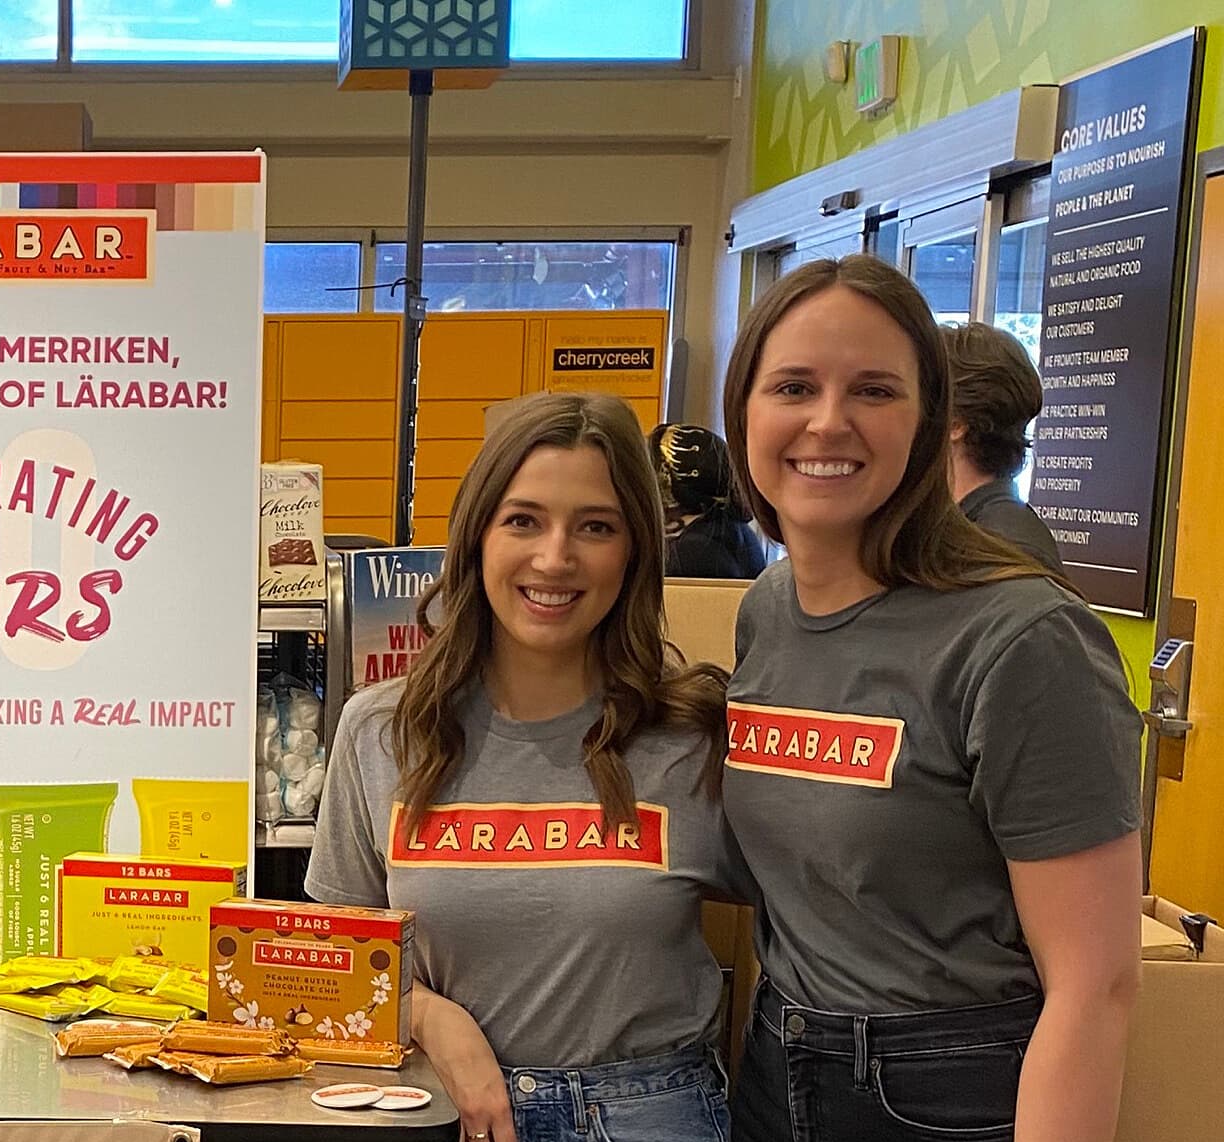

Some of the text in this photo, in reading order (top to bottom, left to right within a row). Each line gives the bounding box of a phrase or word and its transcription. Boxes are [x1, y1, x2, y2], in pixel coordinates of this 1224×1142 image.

[1061, 105, 1146, 153] CORE VALUES
[1058, 141, 1165, 184] OUR PURPOSE IS TO NOURISH
[1056, 185, 1134, 217] PEOPLE & THE PLANET
[1052, 236, 1145, 265] WE SELL THE HIGHEST QUALITY
[38, 264, 47, 274] &
[1050, 260, 1141, 288] NATURAL AND ORGANIC FOOD
[1048, 295, 1123, 316] WE SATISFY AND DELIGHT
[1046, 321, 1095, 339] OUR CUSTOMERS
[559, 350, 649, 368] cherrycreek
[1045, 349, 1129, 368] WE PROMOTE TEAM MEMBER
[1043, 372, 1116, 390] GROWTH AND HAPPINESS
[56, 376, 227, 409] LÄRABAR!
[1041, 404, 1105, 418] WE PRACTICE WIN-WIN
[1039, 426, 1107, 440] SUPPLIER PARTNERSHIPS
[1036, 456, 1093, 469] WE CREATE PROFITS
[1035, 478, 1081, 491] AND PROSPERITY
[260, 495, 320, 517] Chocolove
[276, 520, 304, 532] Milk
[1042, 507, 1057, 521] CARE
[1058, 508, 1077, 522] ABOUT
[1078, 510, 1092, 523] OUR
[1092, 511, 1139, 526] COMMUNITIES
[1051, 529, 1090, 545] NVIRONMENT
[258, 574, 325, 598] Chocolove
[367, 555, 434, 599] Wine
[51, 699, 64, 725] A
[74, 698, 141, 726] REAL
[150, 701, 235, 728] IMPACT
[729, 720, 876, 767] LÄRABAR
[24, 814, 34, 839] NET WT
[407, 820, 641, 852] LÄRABAR
[9, 824, 21, 853] OZ (45g)
[122, 866, 171, 877] 12 BARS
[39, 854, 50, 945] JUST 6 REAL
[276, 916, 330, 930] 12 BARS
[264, 982, 315, 992] CHOCOLATE
[265, 974, 338, 986] PEANUT BUTTER
